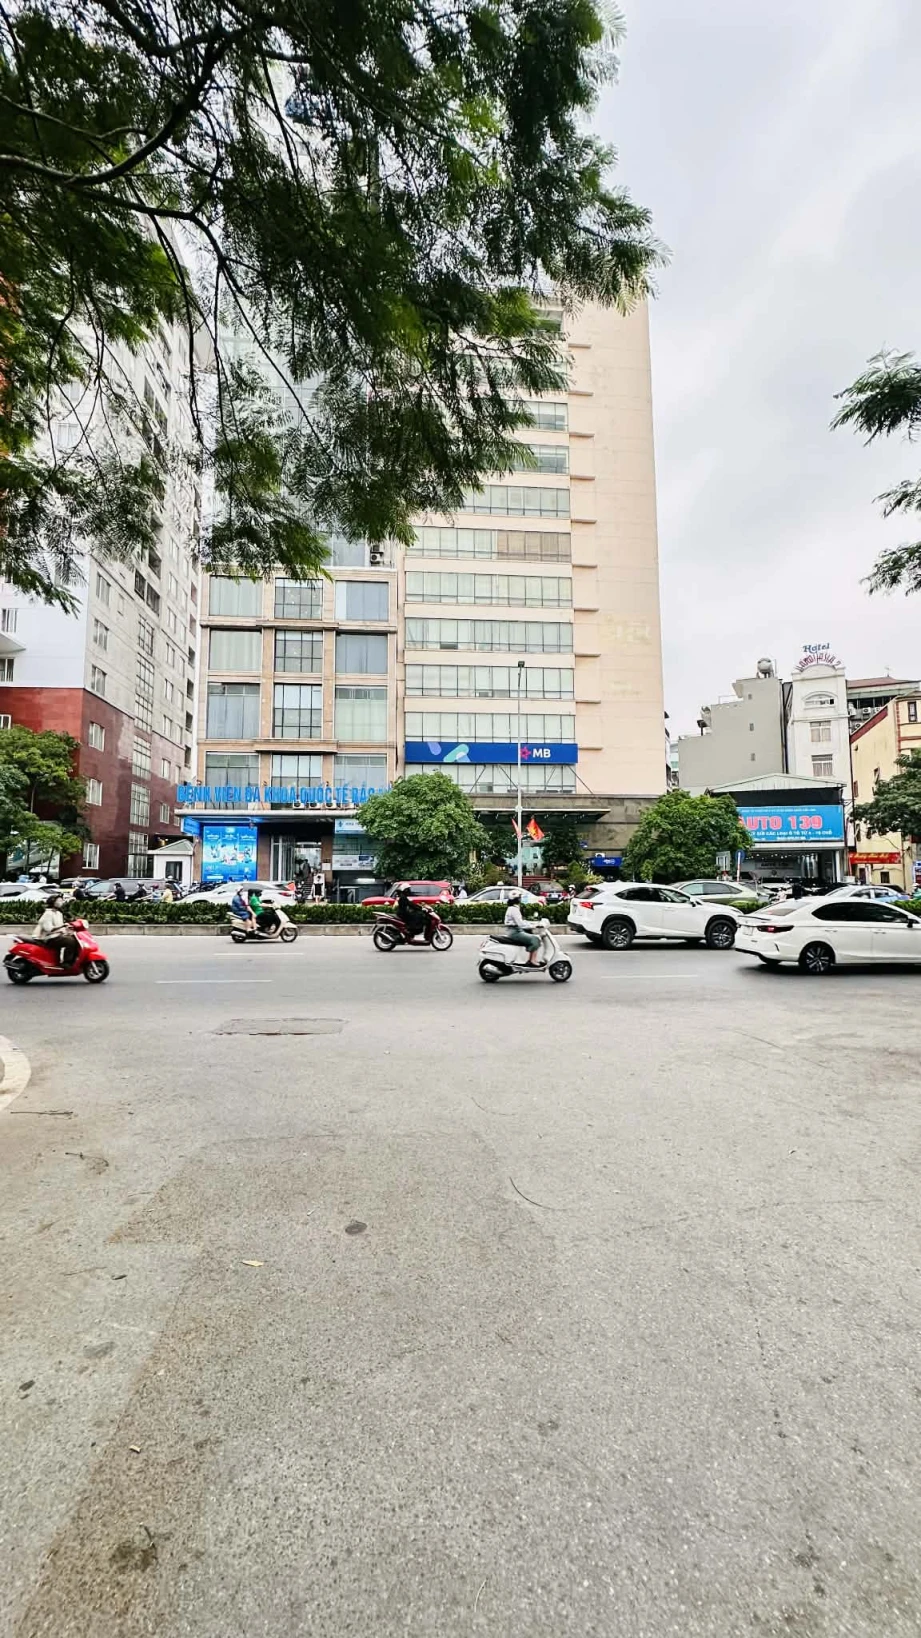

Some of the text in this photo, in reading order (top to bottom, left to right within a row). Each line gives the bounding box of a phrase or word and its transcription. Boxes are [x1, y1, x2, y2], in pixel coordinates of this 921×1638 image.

[802, 643, 830, 654] Hotel
[532, 748, 551, 758] MB
[177, 782, 211, 804] BỆNH
[214, 781, 241, 804] VIỆN
[244, 786, 261, 803] ĐA
[264, 786, 296, 803] KHOA
[300, 783, 332, 804] QUỐC
[335, 783, 350, 803] TẾ
[788, 815, 823, 829] 139
